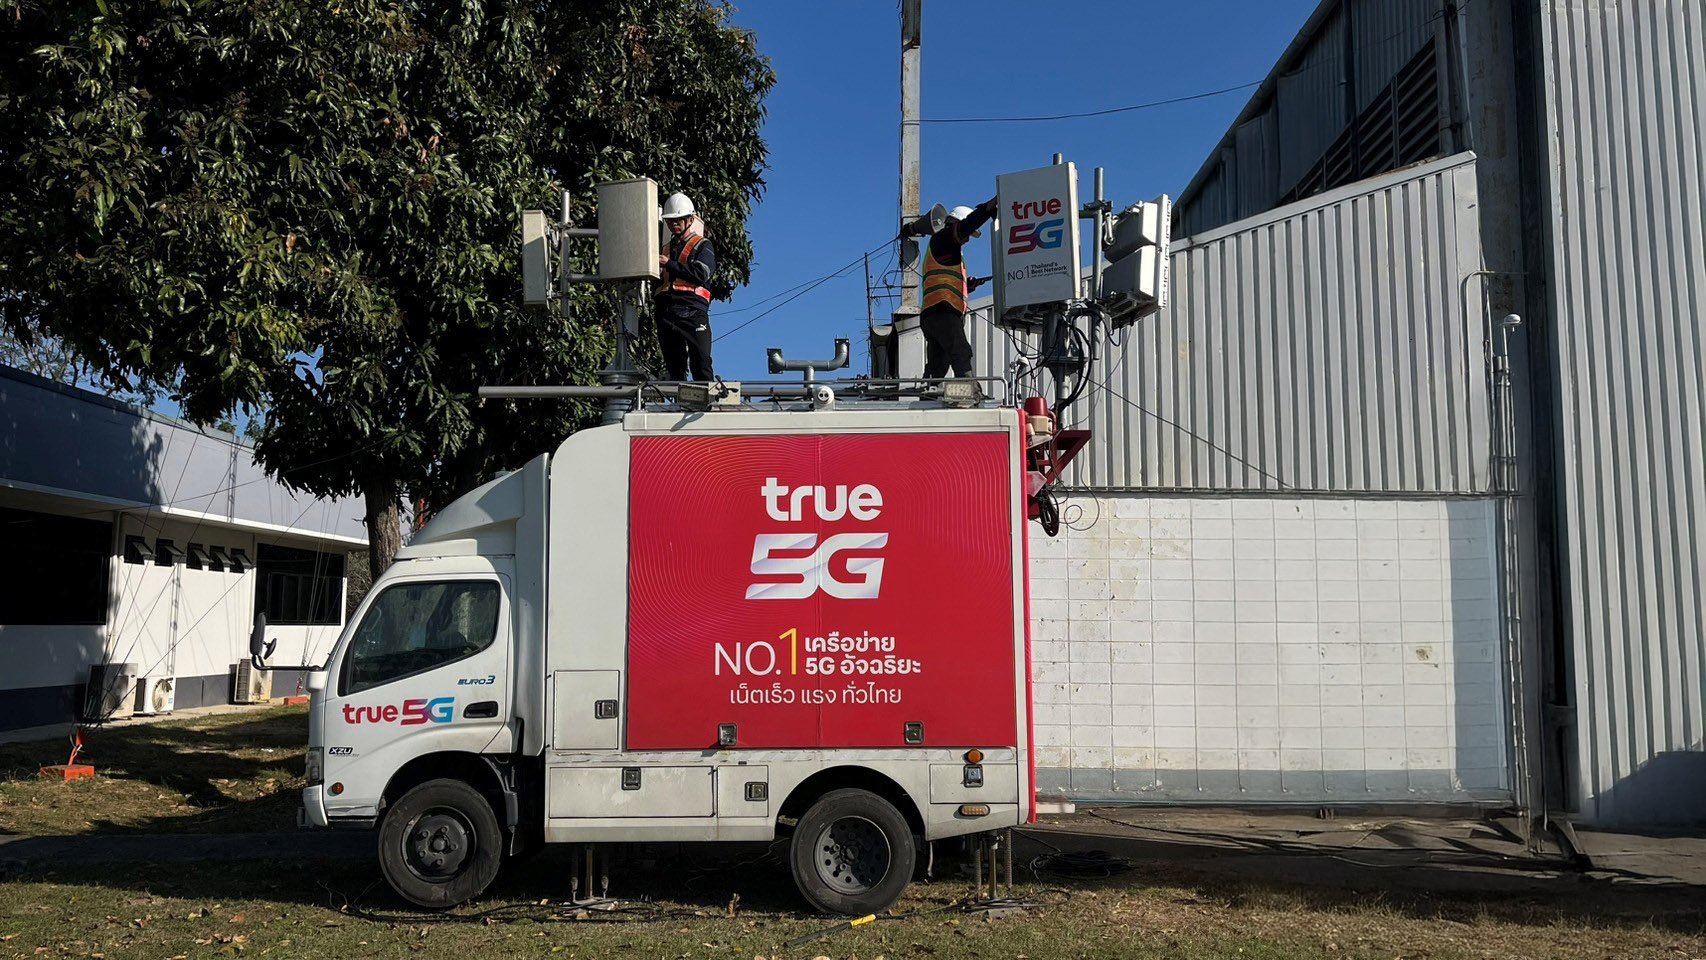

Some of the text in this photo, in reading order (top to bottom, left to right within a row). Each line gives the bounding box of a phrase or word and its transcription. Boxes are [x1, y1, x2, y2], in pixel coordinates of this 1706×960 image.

[1012, 198, 1062, 220] true
[1008, 218, 1065, 255] 5G
[1007, 265, 1030, 281] NO.1
[1044, 265, 1067, 273] Network
[761, 477, 883, 522] true
[745, 532, 889, 600] 5G
[714, 628, 797, 676] NO.1
[805, 631, 895, 653] เครือข่าย
[805, 654, 921, 675] 5G อัจฉริยะ
[730, 681, 902, 704] เน็ตเร็ว แรง ทั่วไทย
[342, 696, 455, 726] true 5G
